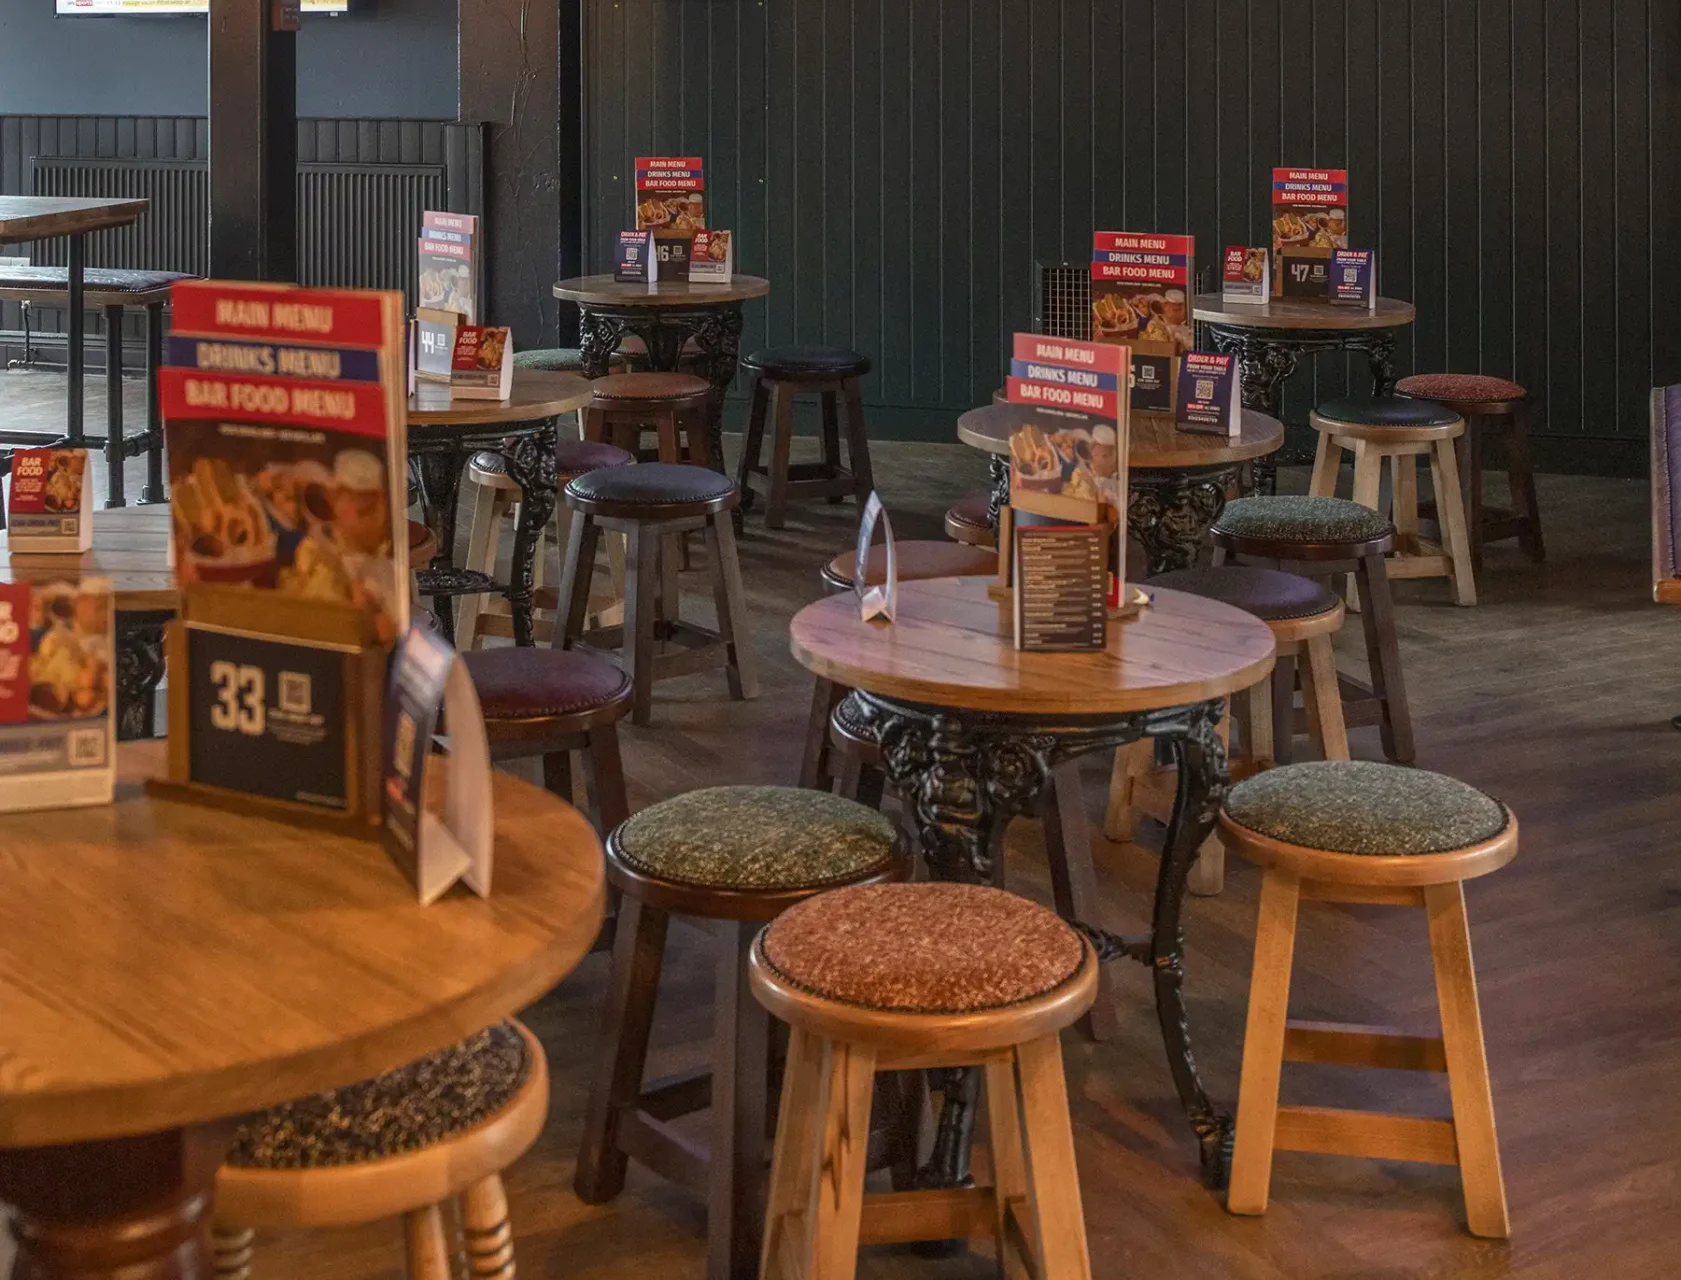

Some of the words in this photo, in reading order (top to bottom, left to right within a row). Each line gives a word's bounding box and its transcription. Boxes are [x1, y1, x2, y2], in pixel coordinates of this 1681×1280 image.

[1289, 172, 1307, 180] MAIN
[1308, 173, 1328, 181] MENU
[1285, 183, 1310, 191] DRINKS
[1317, 194, 1337, 202] MENU
[424, 242, 434, 251] BAR
[435, 243, 449, 253] FOOD
[449, 245, 464, 256] MENU
[1115, 238, 1138, 248] MAIN
[1140, 239, 1166, 250] MENU
[1109, 252, 1142, 263] DRINKS
[1143, 254, 1170, 265] MENU
[1103, 266, 1121, 276] BAR
[1122, 267, 1147, 278] FOOD
[1149, 268, 1175, 279] MENU
[1291, 265, 1309, 282] 47
[216, 299, 270, 329] MAIN
[272, 302, 333, 333] MENU
[421, 330, 435, 354] 44
[459, 337, 477, 345] FOOD
[196, 342, 275, 373] DRINKS
[277, 347, 341, 379] MENU
[1036, 344, 1062, 360] MAIN
[1064, 347, 1095, 364] MENU
[1027, 365, 1066, 383] DRINKS
[1067, 370, 1098, 387] MENU
[184, 379, 228, 408] BAR
[230, 384, 289, 414] FOOD
[291, 388, 355, 420] MENU
[1020, 384, 1041, 399] BAR
[1043, 387, 1071, 404] FOOD
[1073, 392, 1104, 409] MENU
[21, 457, 41, 466] BAR
[17, 466, 43, 476] FOOD
[210, 660, 266, 736] 33
